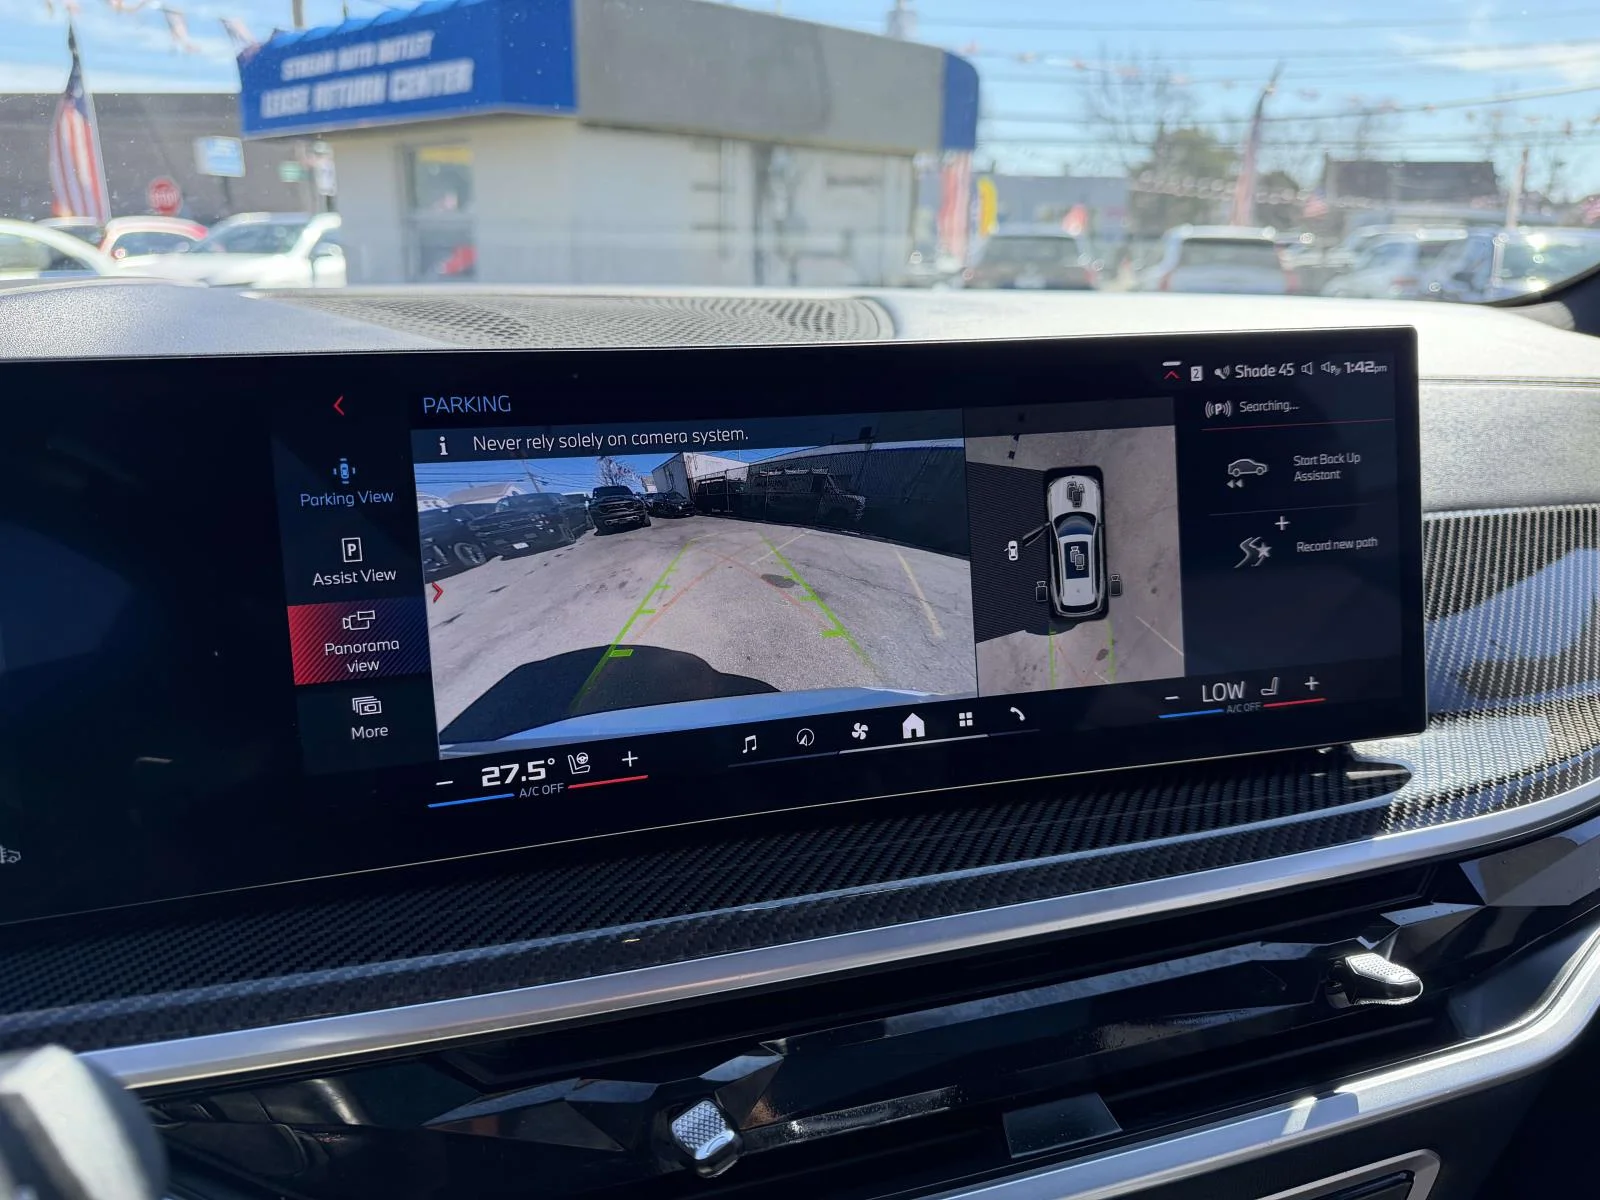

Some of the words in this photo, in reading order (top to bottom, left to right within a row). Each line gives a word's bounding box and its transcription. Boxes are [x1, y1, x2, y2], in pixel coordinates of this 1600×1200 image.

[387, 58, 475, 102] CENTER
[1235, 364, 1276, 379] Shade
[1278, 362, 1296, 376] 45
[1343, 361, 1388, 374] 1:42pm
[423, 395, 512, 415] PARKING
[1239, 400, 1300, 414] Searching...
[472, 434, 521, 452] Never
[526, 432, 555, 452] rely
[559, 431, 603, 450] solely
[607, 431, 628, 447] on
[631, 430, 688, 445] camera
[691, 426, 749, 445] system.
[1293, 456, 1319, 467] Start
[1320, 453, 1345, 465] Back
[1346, 452, 1361, 465] Up
[1294, 470, 1342, 482] Assistant
[300, 490, 355, 508] Parking
[357, 490, 394, 504] View
[1296, 540, 1332, 553] Record
[1333, 540, 1354, 550] new
[1355, 537, 1379, 551] path
[312, 571, 358, 586] Assist
[360, 568, 397, 583] View
[324, 638, 400, 656] Panorama
[346, 659, 381, 673] view
[1202, 681, 1246, 703] LOW
[1226, 704, 1243, 714] A/C
[1244, 702, 1262, 713] OFF
[351, 724, 389, 740] More
[519, 785, 541, 799] A/C
[541, 782, 565, 796] OFF
